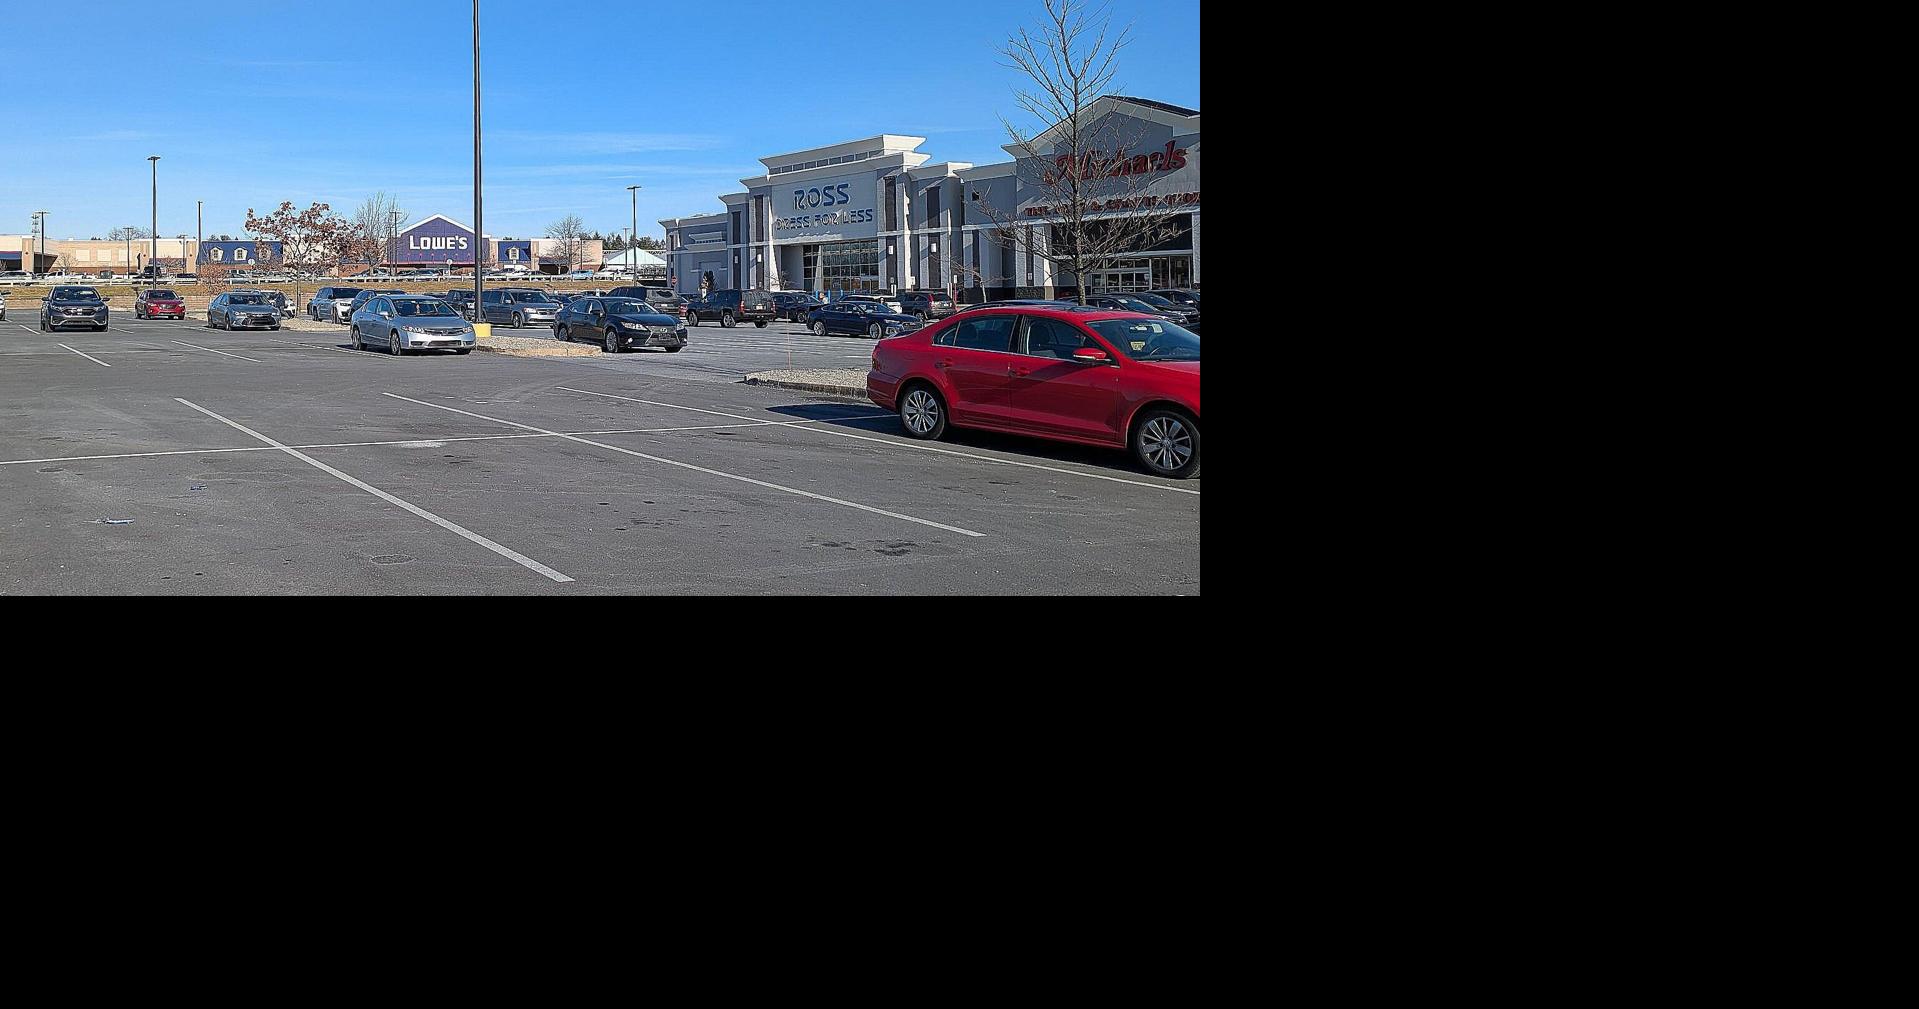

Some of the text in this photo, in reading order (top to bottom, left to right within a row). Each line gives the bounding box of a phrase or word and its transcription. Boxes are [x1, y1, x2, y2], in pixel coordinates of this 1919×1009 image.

[1044, 140, 1188, 184] Michaels
[794, 184, 850, 209] ROSS
[776, 209, 873, 230] DRESS FOR LESS
[409, 235, 468, 250] LOWE'S
